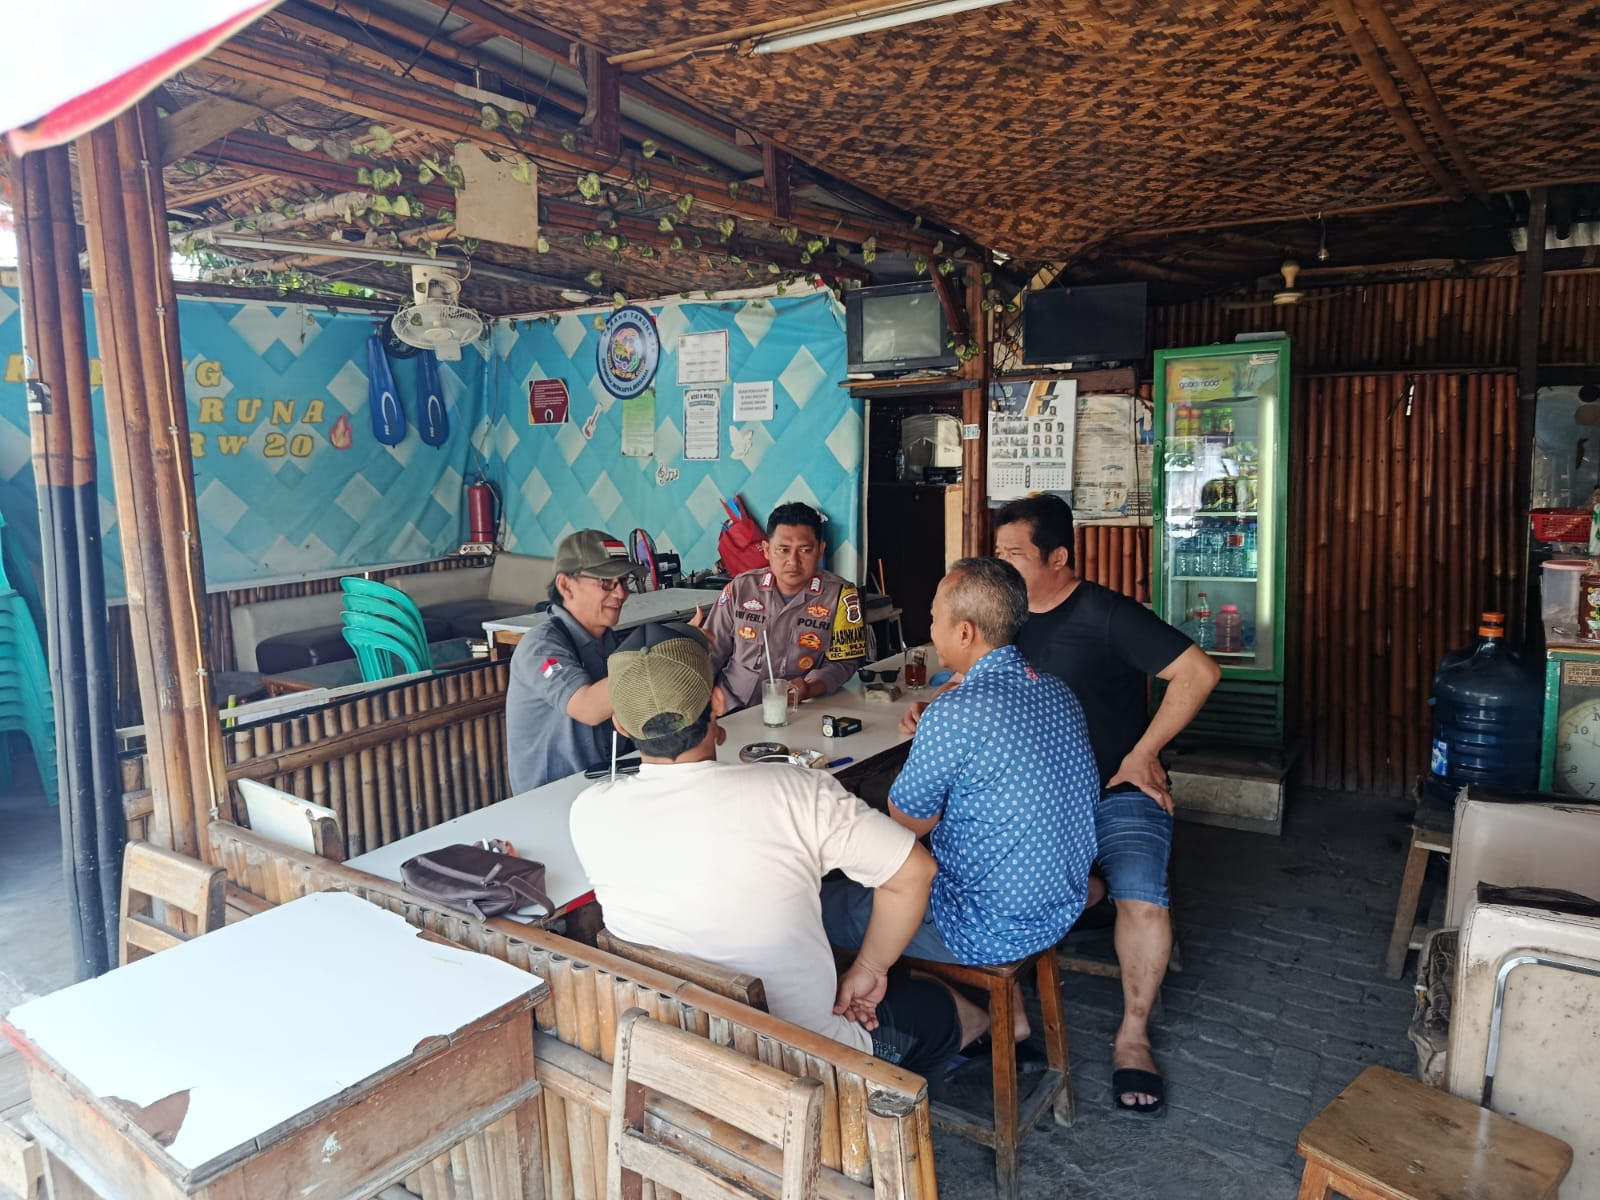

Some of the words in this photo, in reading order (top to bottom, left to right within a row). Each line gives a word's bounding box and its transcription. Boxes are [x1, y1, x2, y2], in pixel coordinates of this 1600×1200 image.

[198, 397, 326, 425] RUNA
[263, 432, 315, 458] 20
[797, 617, 831, 631] POLRI
[1573, 726, 1589, 735] 10
